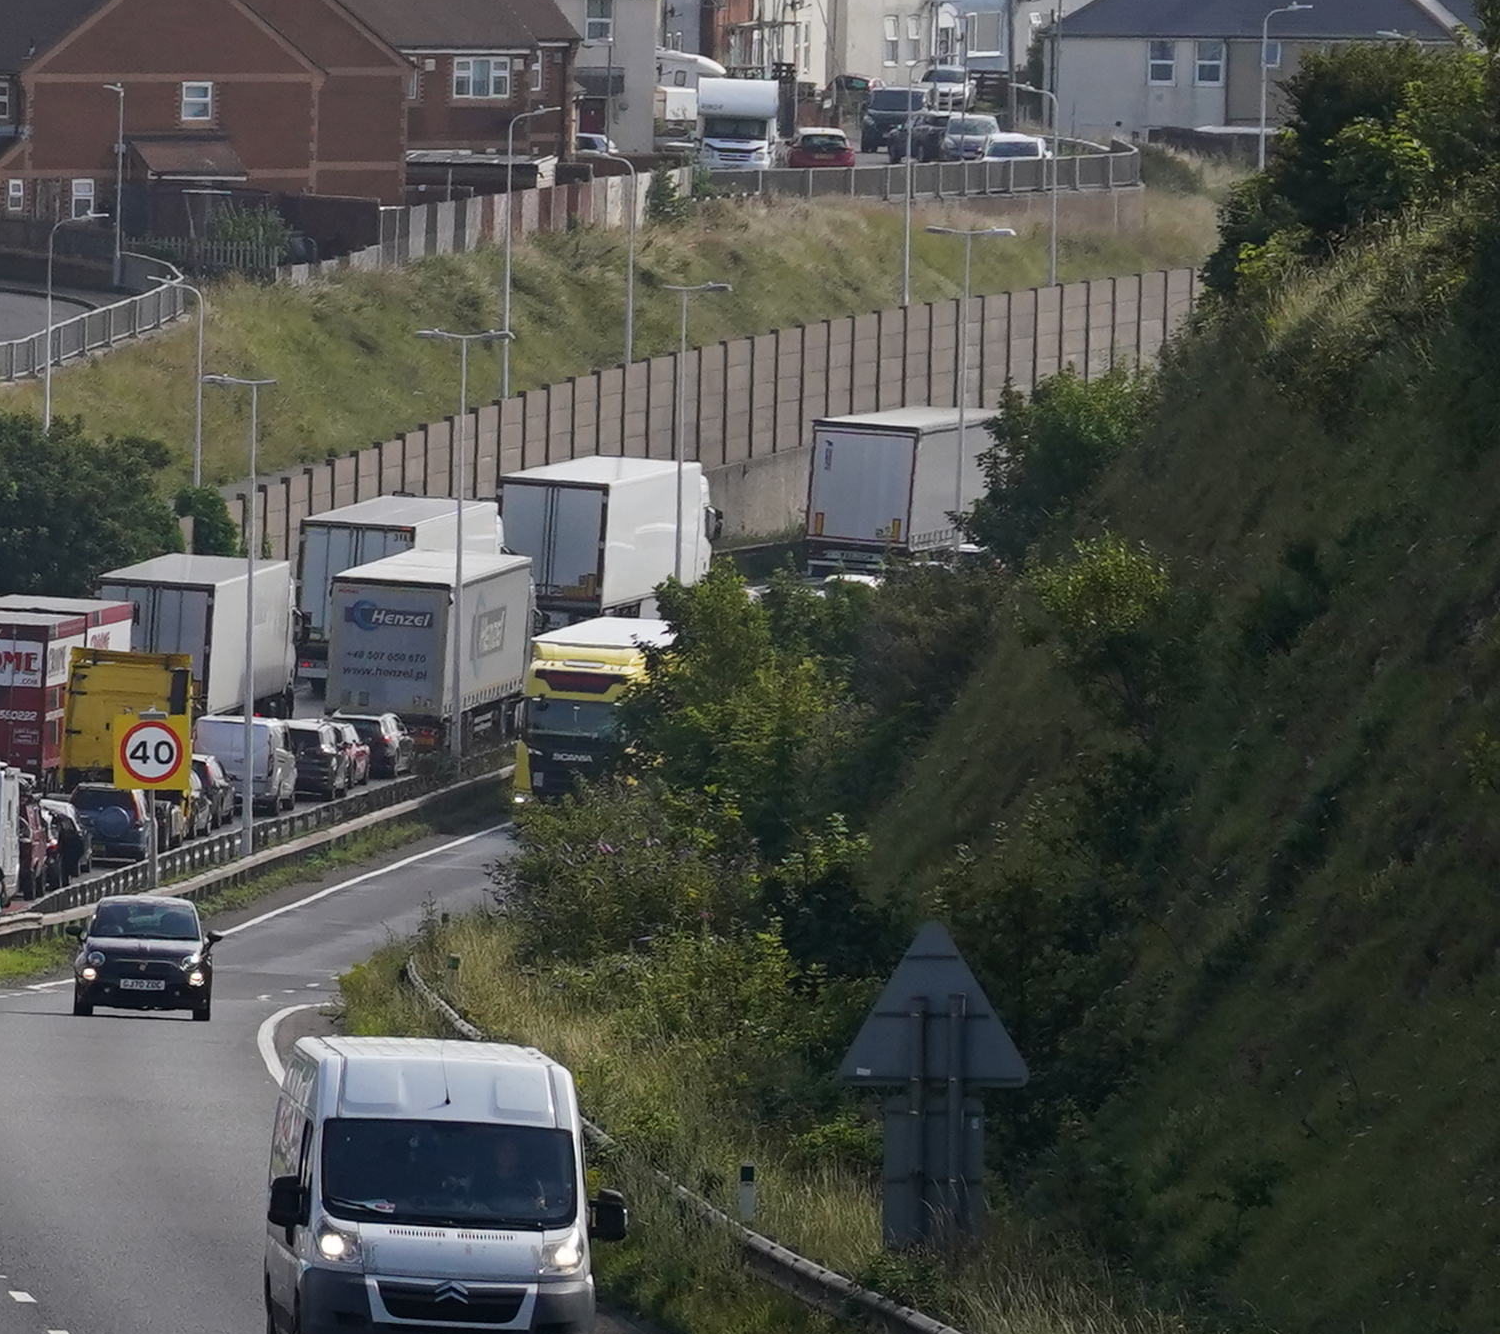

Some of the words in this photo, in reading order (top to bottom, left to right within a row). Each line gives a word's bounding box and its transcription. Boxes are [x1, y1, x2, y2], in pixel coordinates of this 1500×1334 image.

[371, 609, 431, 627] Henzel
[342, 667, 427, 681] www.henzel.pl
[130, 740, 174, 765] 40
[552, 753, 593, 763] SCANIA
